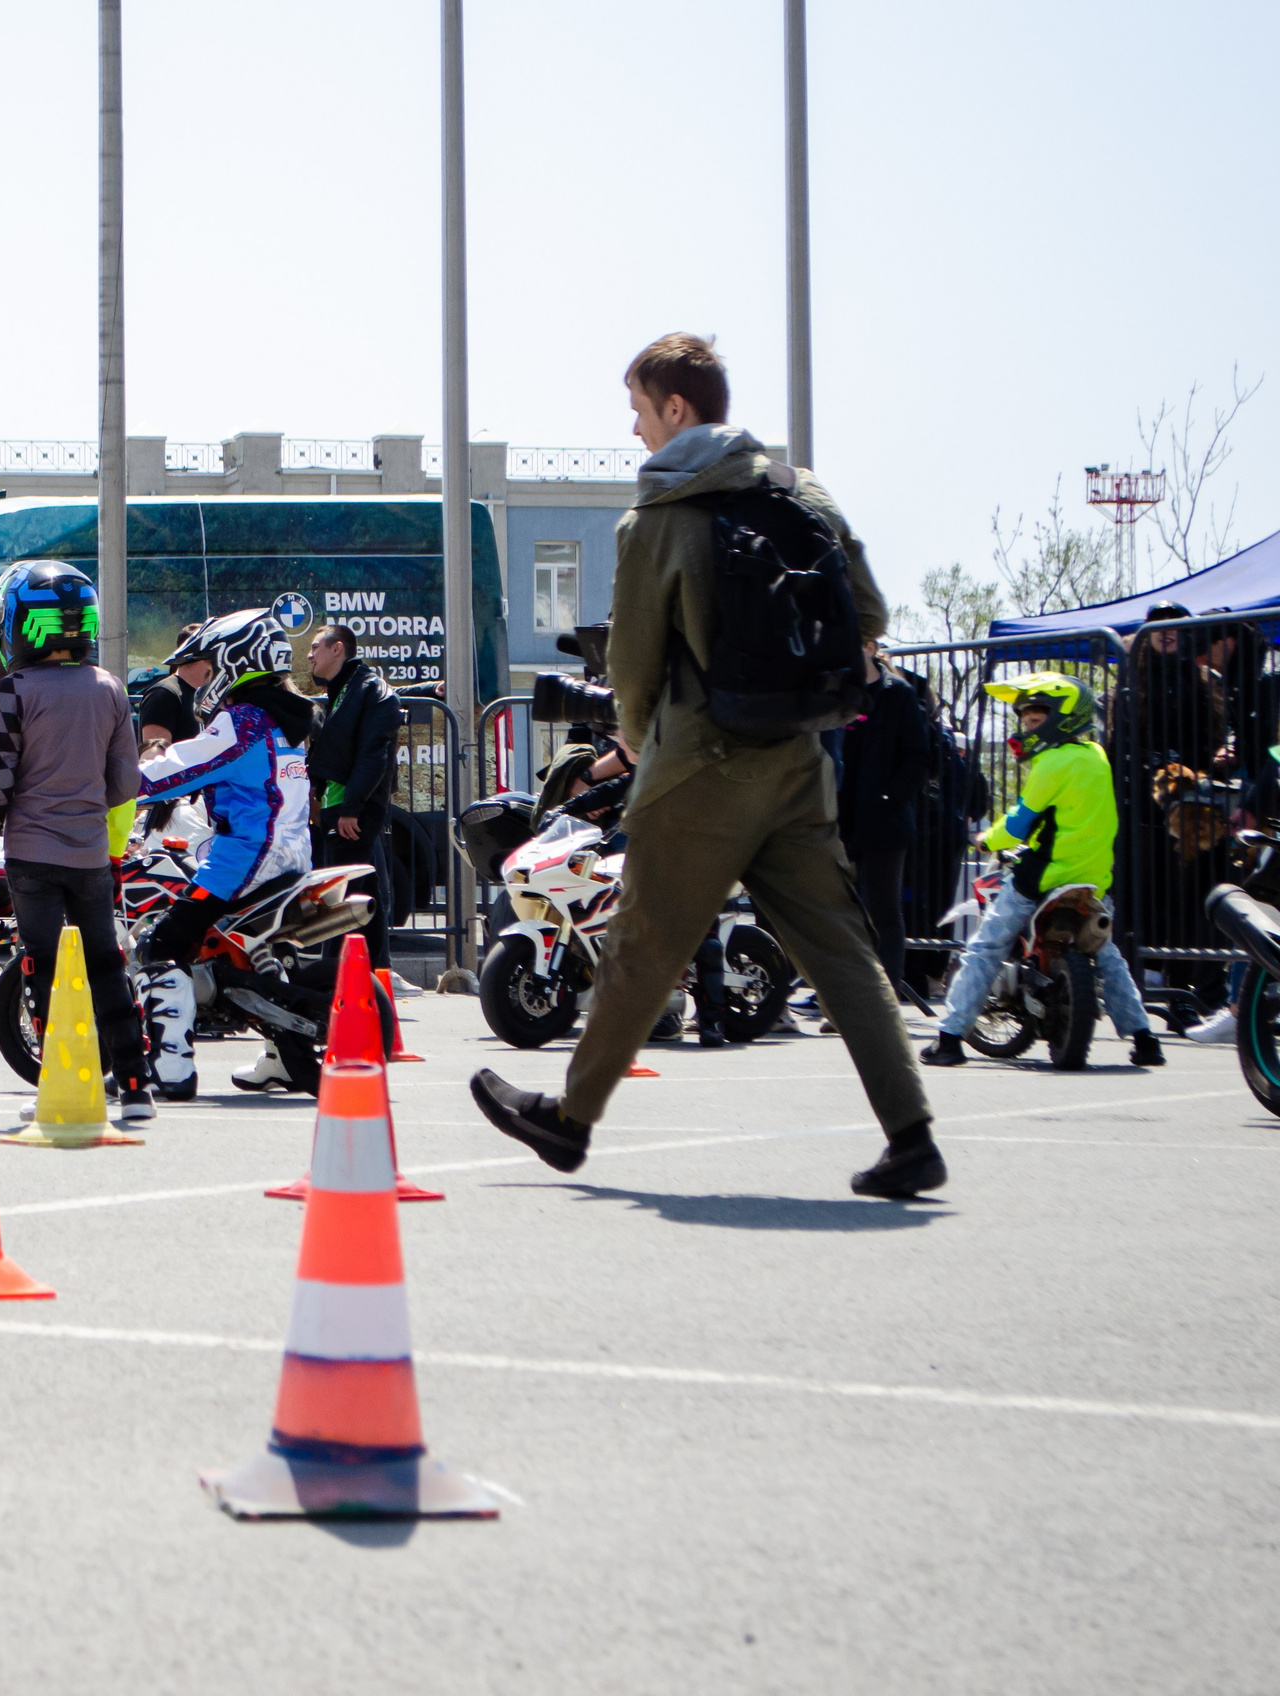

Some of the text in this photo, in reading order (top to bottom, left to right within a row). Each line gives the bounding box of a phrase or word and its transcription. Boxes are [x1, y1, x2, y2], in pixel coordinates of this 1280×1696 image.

[325, 592, 386, 612] BMW
[326, 616, 445, 636] OTORRA
[356, 640, 445, 662] емьер Ав
[389, 666, 417, 680] 230
[420, 666, 440, 680] 30
